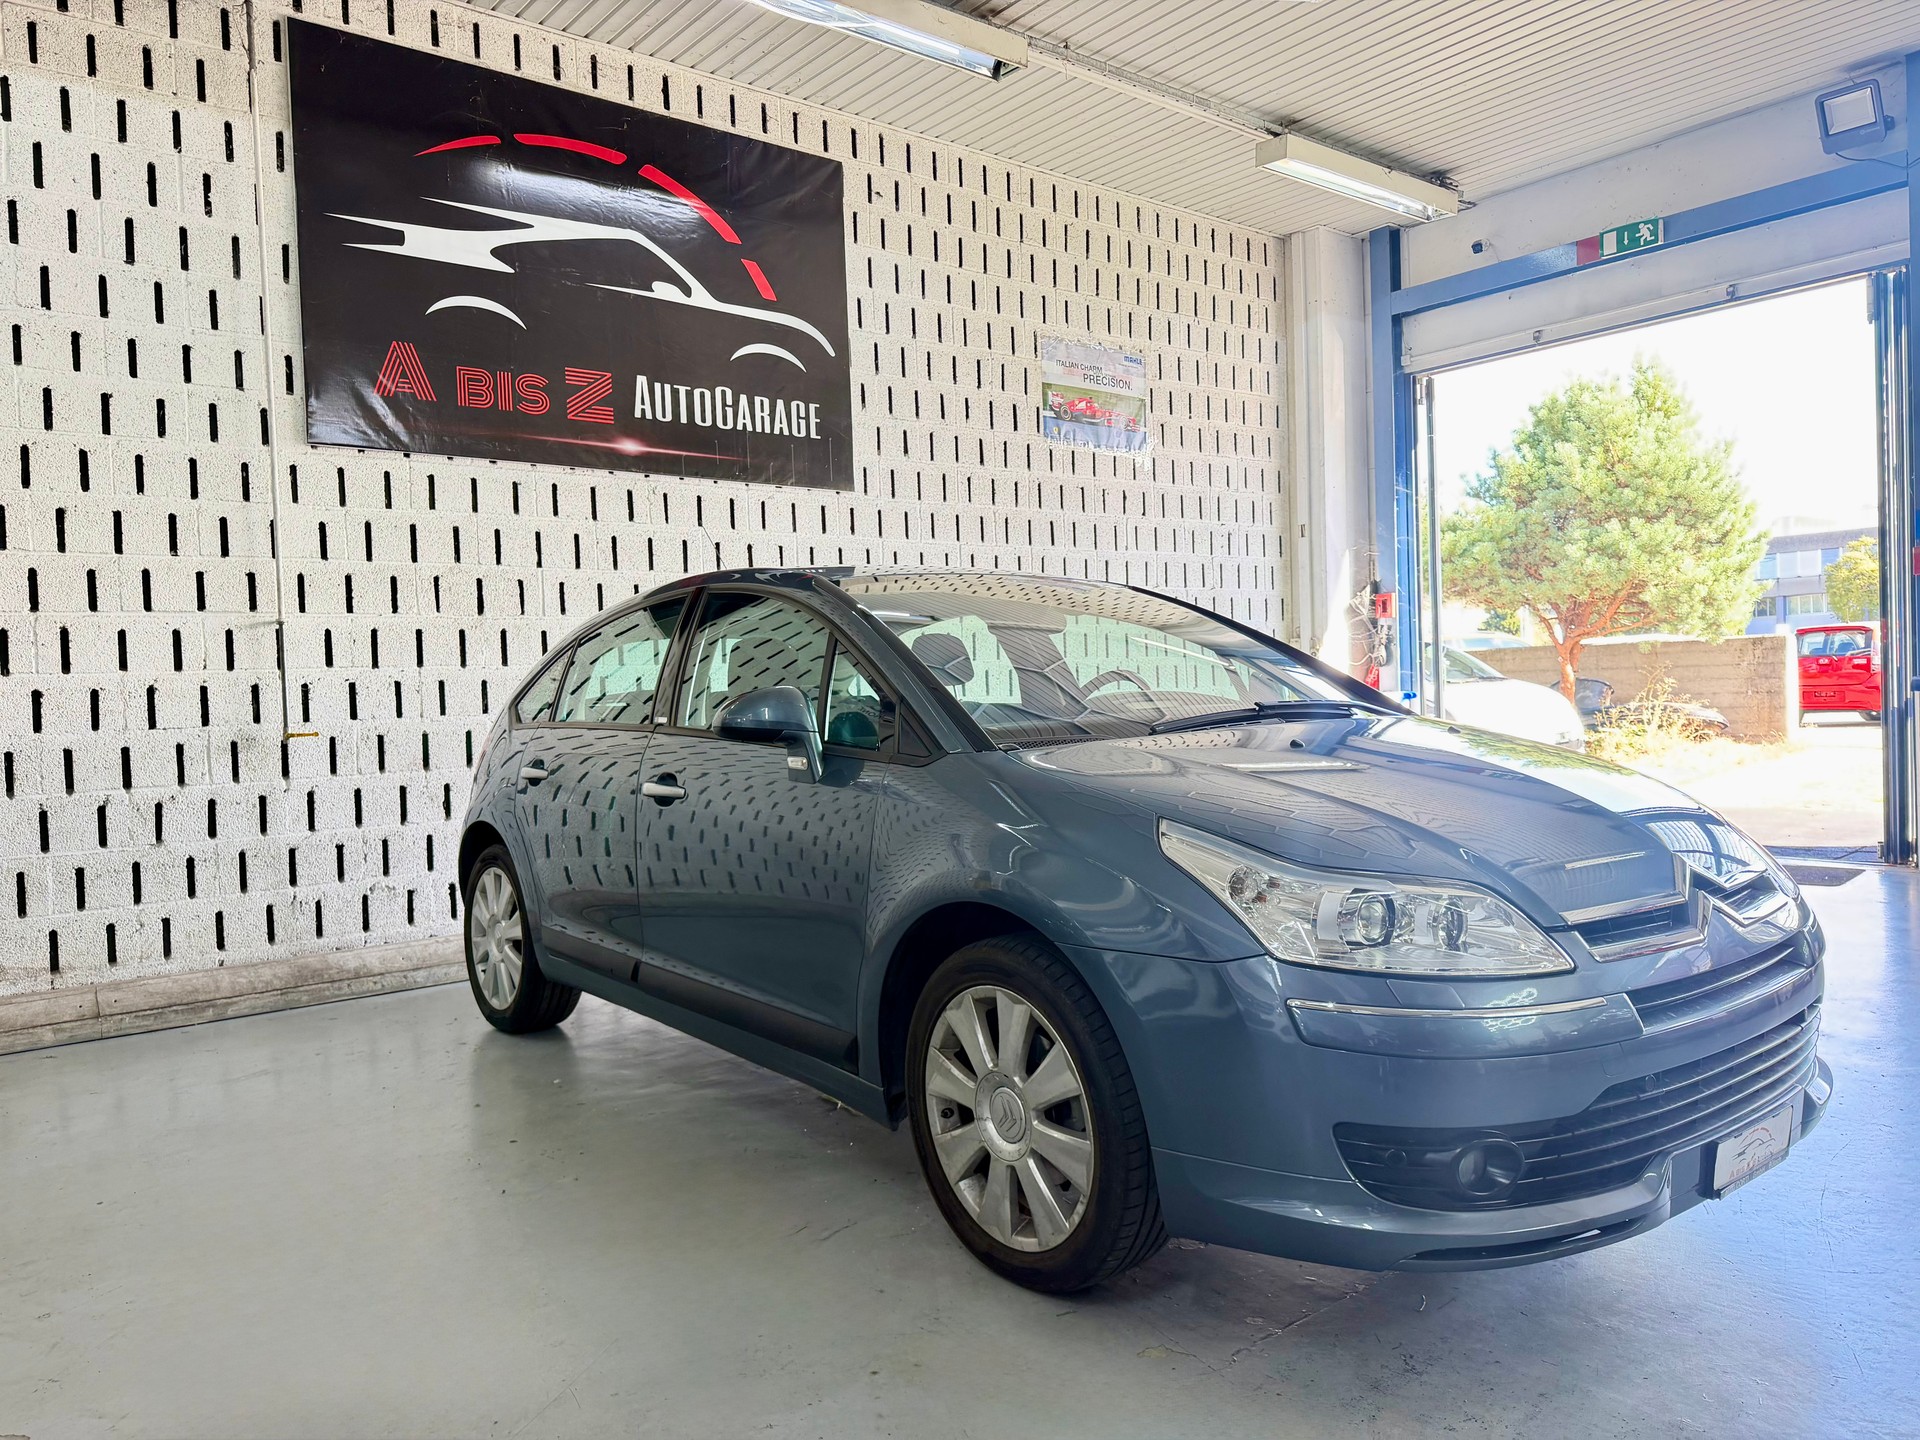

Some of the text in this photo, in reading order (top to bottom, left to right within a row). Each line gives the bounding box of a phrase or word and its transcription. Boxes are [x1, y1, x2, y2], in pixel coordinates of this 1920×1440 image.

[1055, 359, 1080, 370] ITALIAN
[374, 341, 437, 401] A
[456, 365, 550, 415] BIS
[565, 367, 615, 424] Z
[1082, 373, 1133, 391] PRECISION.
